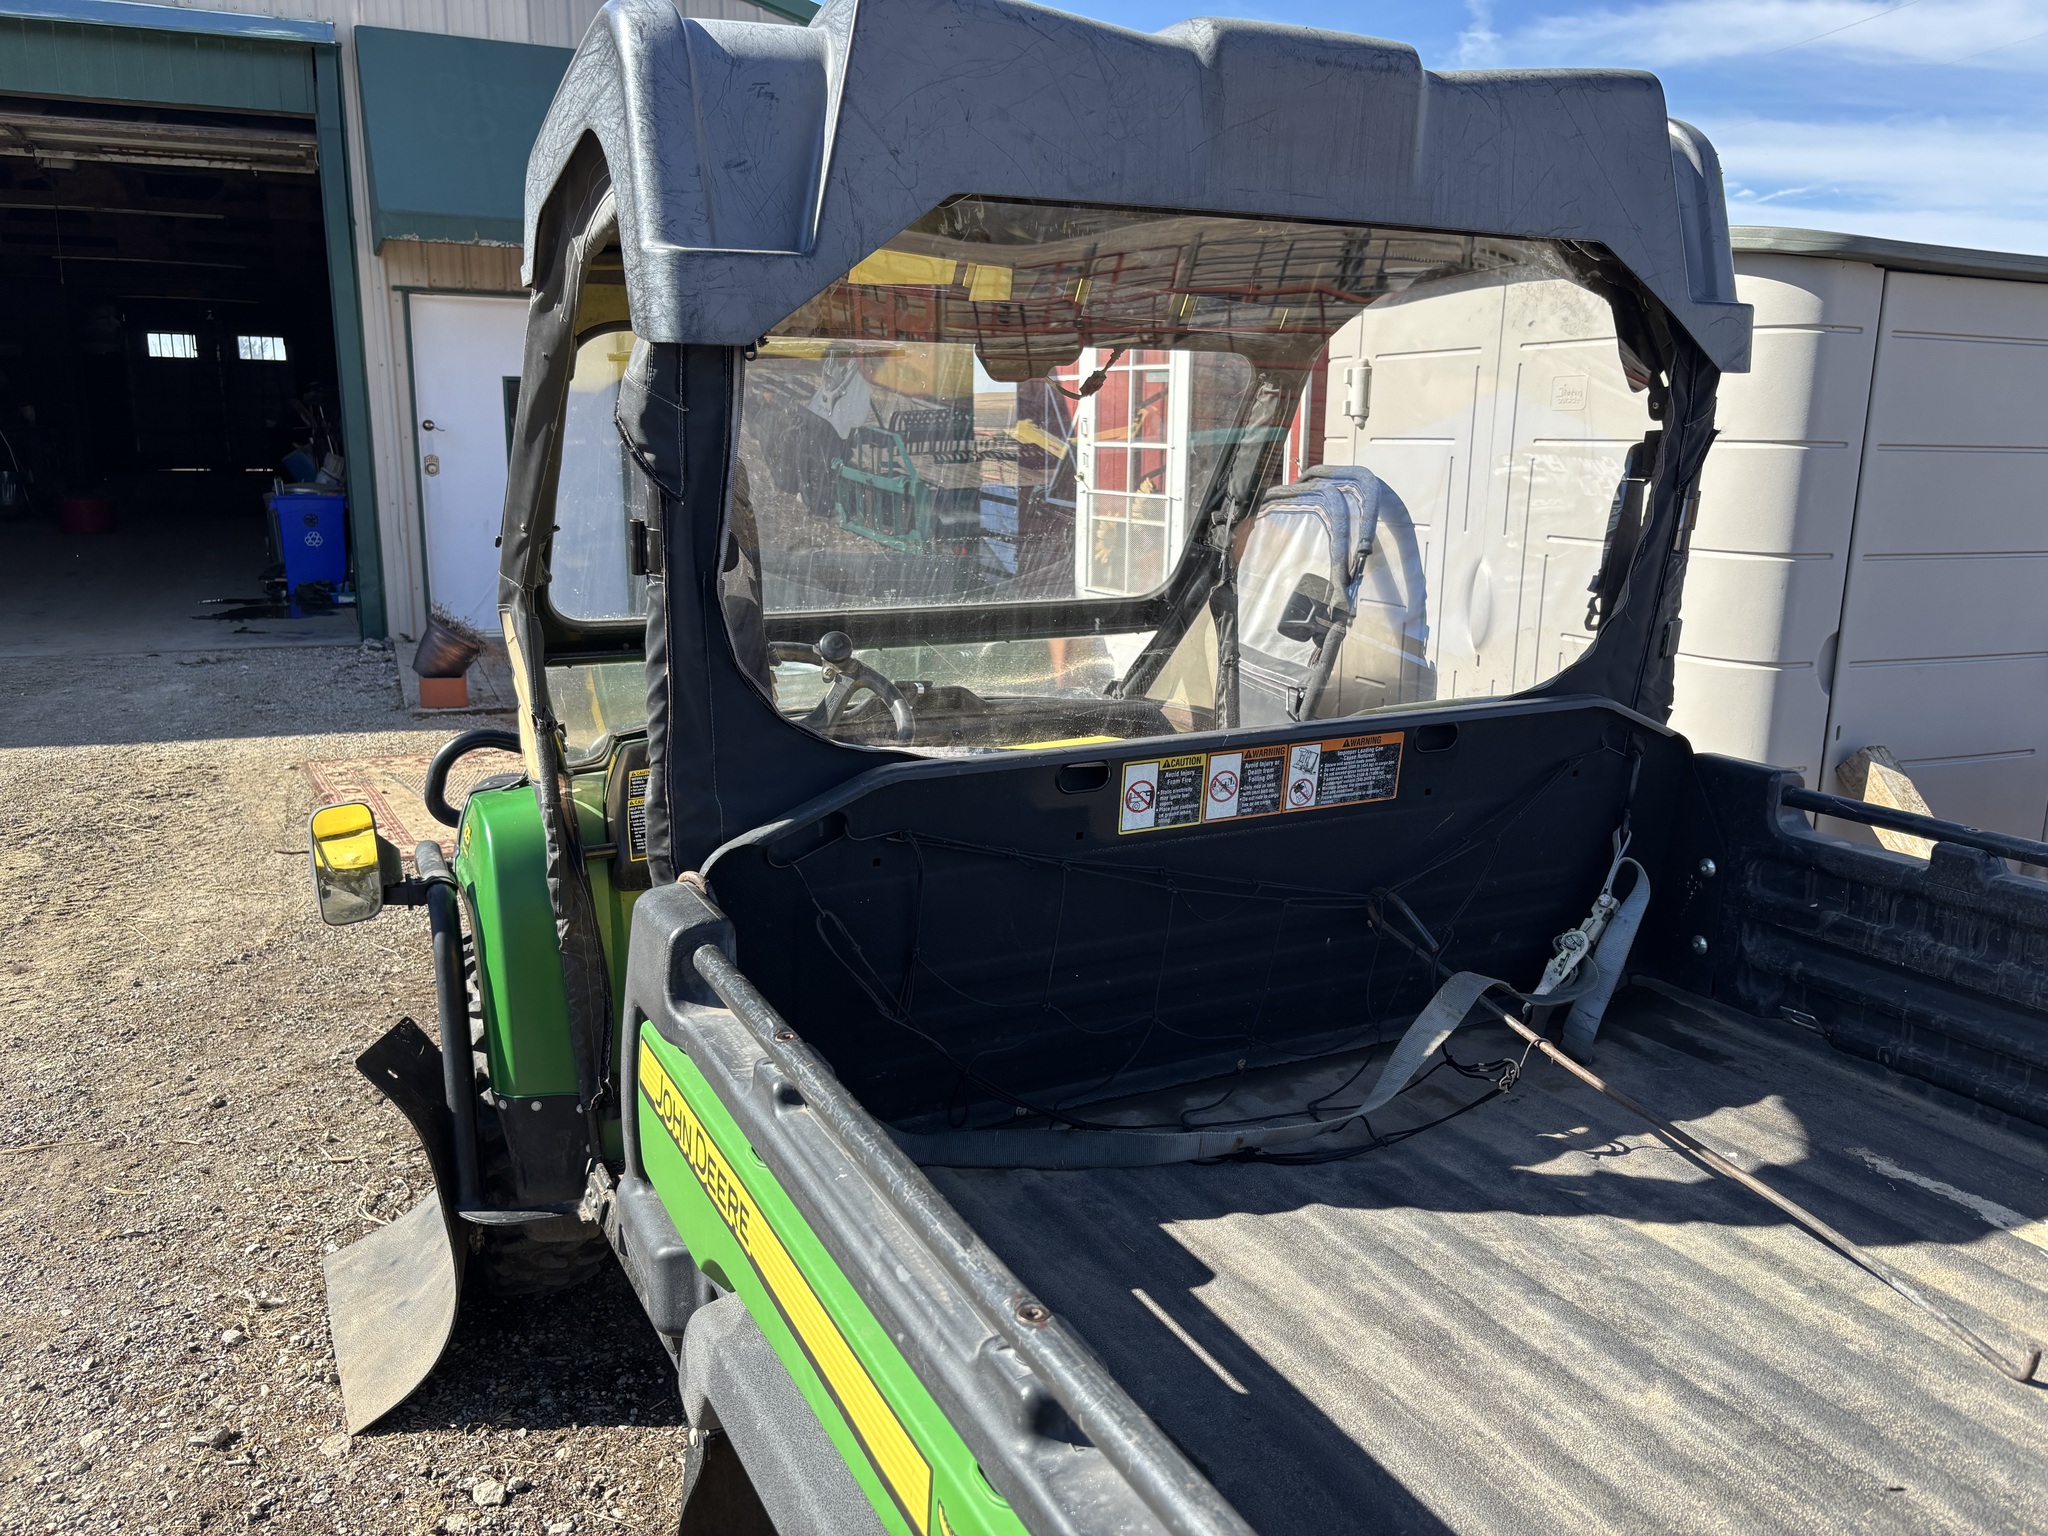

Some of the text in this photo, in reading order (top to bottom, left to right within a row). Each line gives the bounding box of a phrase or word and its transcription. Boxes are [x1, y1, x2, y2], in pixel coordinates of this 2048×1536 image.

[1350, 736, 1382, 747] WARNING
[1252, 747, 1285, 758] WARNING
[1170, 756, 1202, 768] CAUTION
[1244, 761, 1259, 769] Avoid
[1259, 760, 1274, 768] Injury
[1164, 770, 1180, 778] Avoid
[1247, 768, 1262, 776] Death
[655, 1074, 693, 1158] JOHN
[695, 1126, 750, 1248] DEERE
